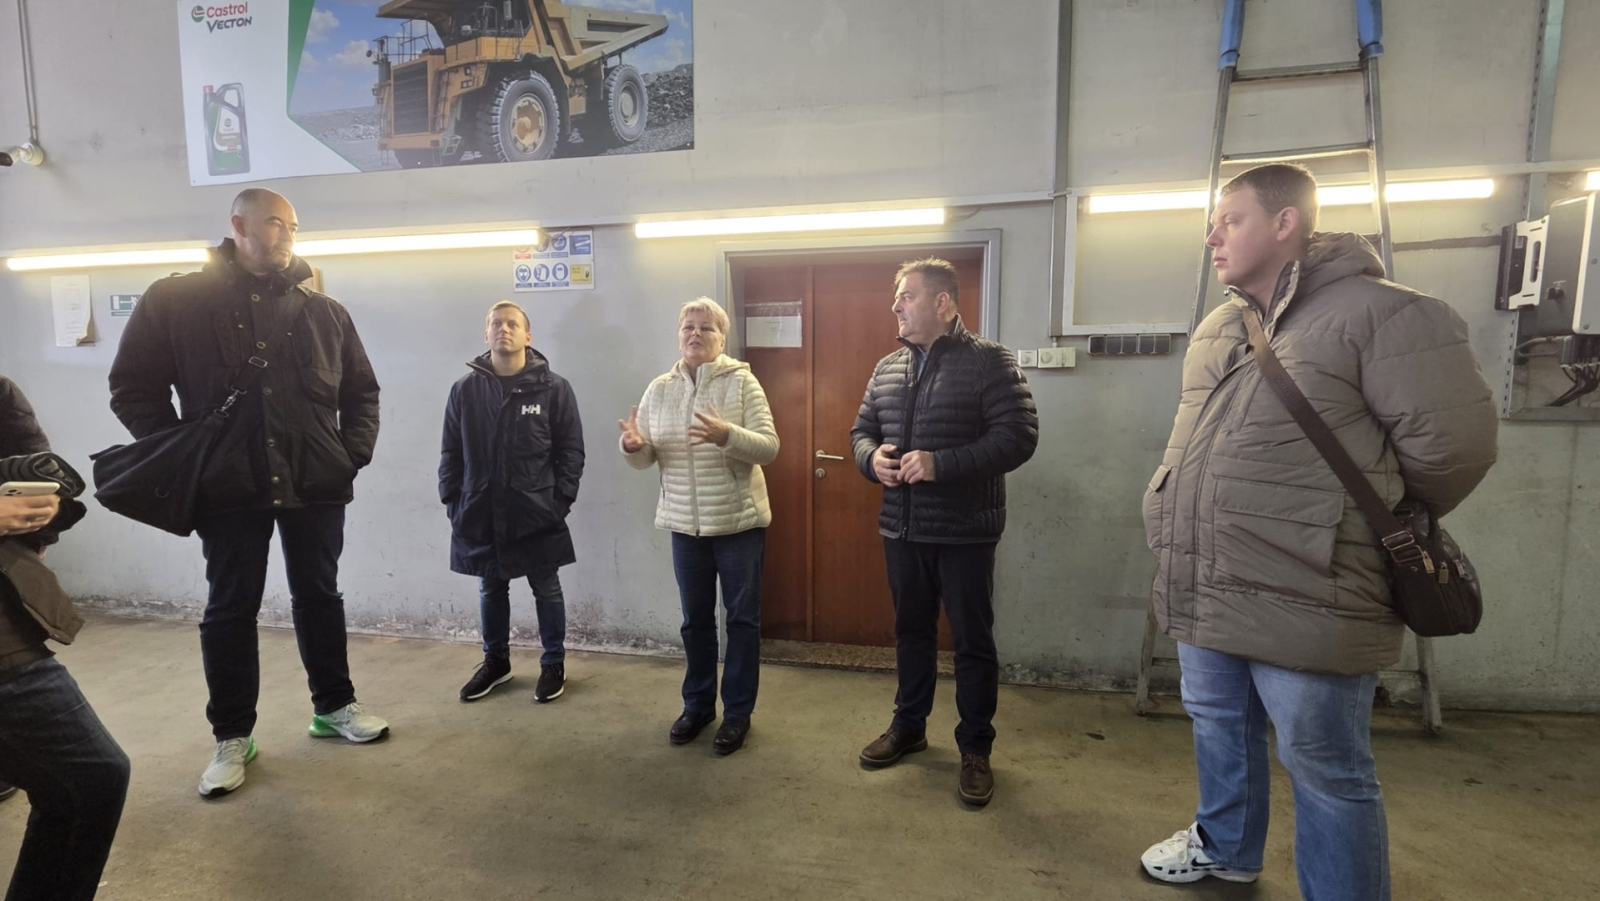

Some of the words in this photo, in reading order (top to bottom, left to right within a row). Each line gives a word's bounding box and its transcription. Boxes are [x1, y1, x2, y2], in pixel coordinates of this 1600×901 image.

[206, 1, 248, 18] Castrol
[206, 16, 253, 34] VECTON
[521, 404, 541, 415] HH
